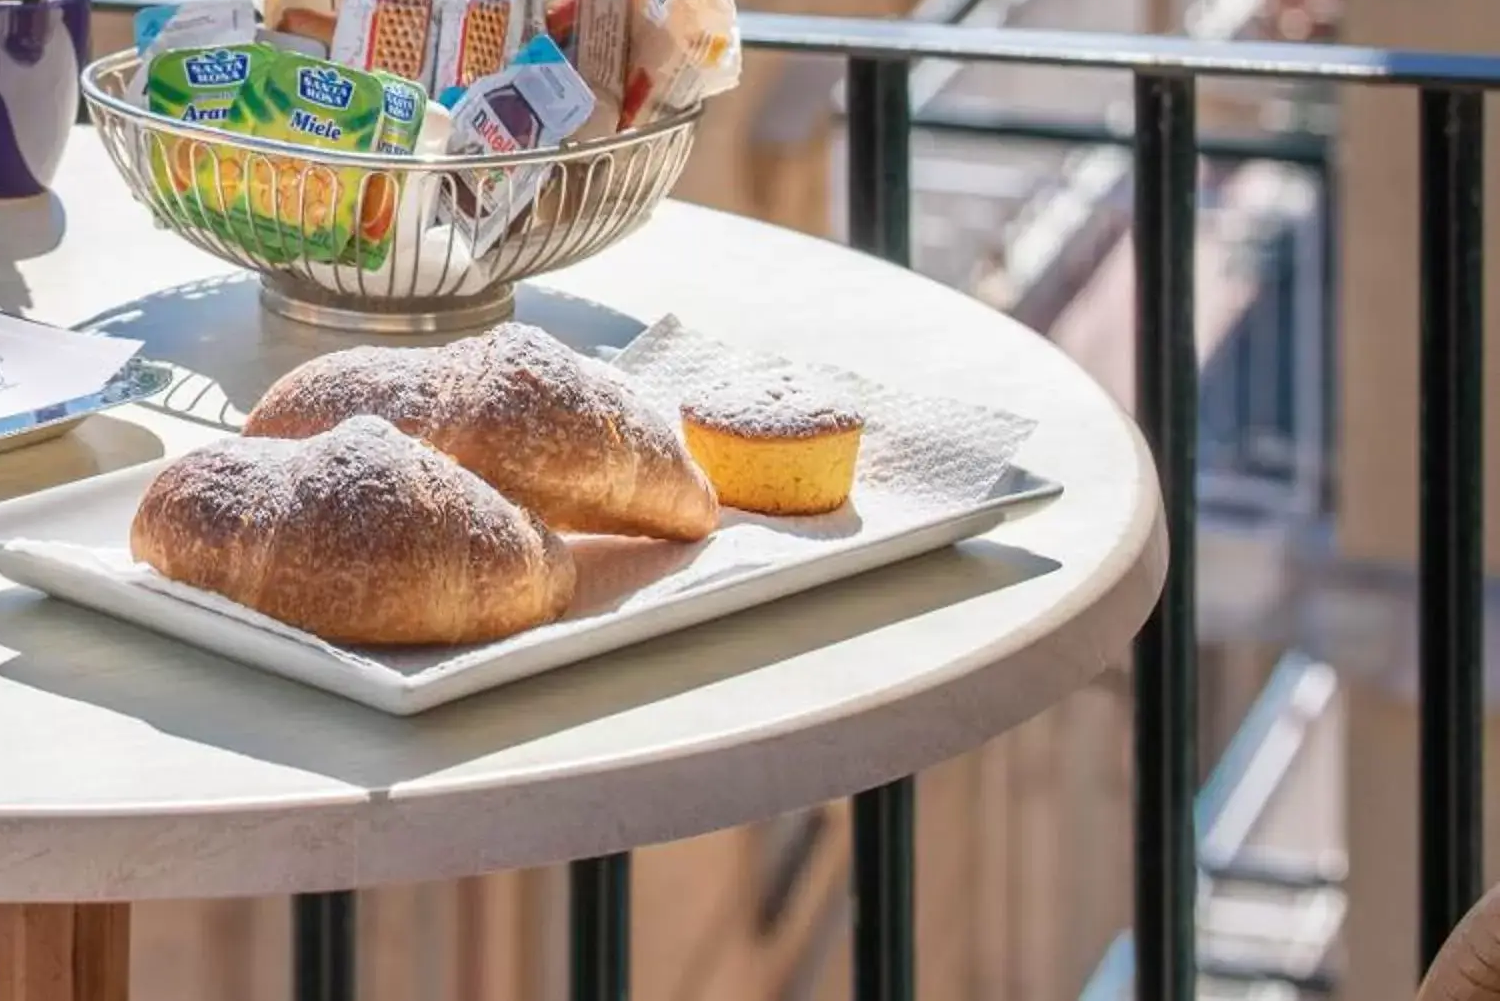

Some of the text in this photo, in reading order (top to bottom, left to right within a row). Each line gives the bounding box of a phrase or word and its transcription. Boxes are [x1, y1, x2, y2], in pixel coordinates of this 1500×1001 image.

[190, 59, 243, 74] SANTA
[197, 70, 241, 81] ROSA
[303, 75, 349, 98] SANTA
[305, 88, 343, 105] ROSA
[290, 110, 342, 140] Miele
